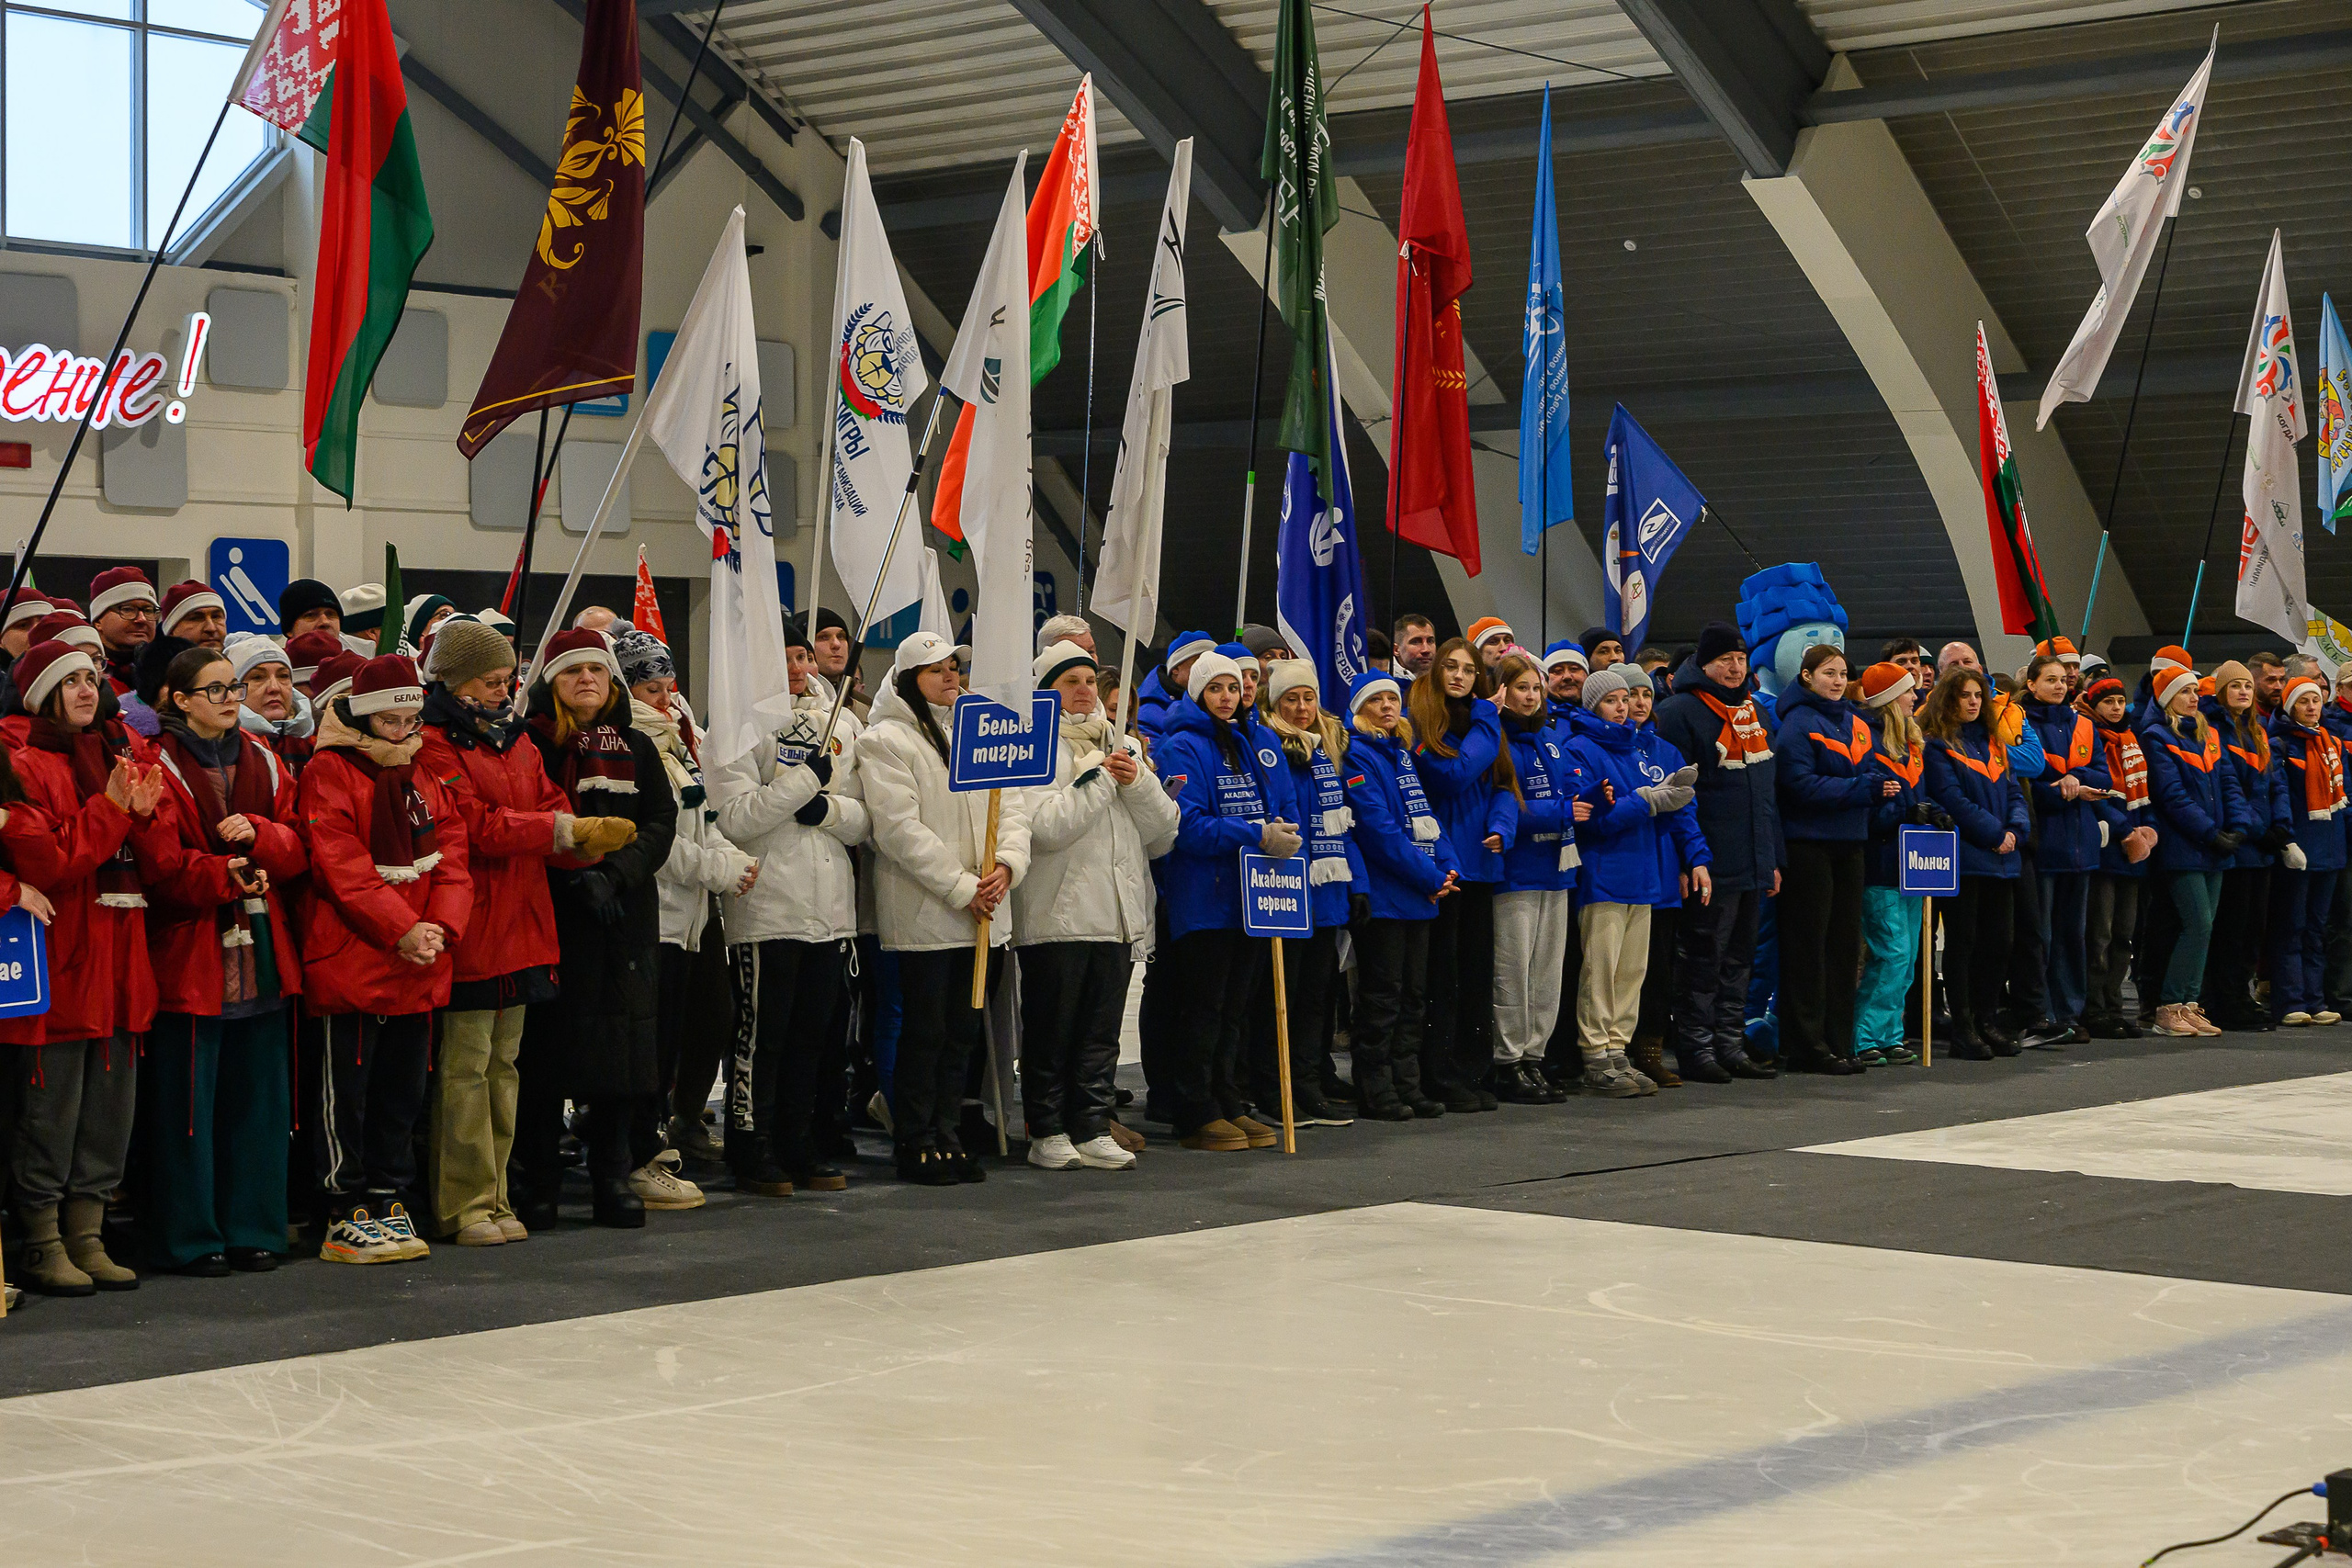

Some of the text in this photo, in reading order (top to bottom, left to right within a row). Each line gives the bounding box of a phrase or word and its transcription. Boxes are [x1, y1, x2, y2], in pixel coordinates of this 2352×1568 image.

[2276, 413, 2294, 442] КОГДА
[1335, 641, 1356, 687] СЕРВИ
[978, 713, 1034, 738] Белые
[972, 742, 1035, 768] тигры
[1908, 850, 1951, 871] Молния
[1250, 867, 1302, 890] Академия
[1257, 895, 1298, 917] сервиса
